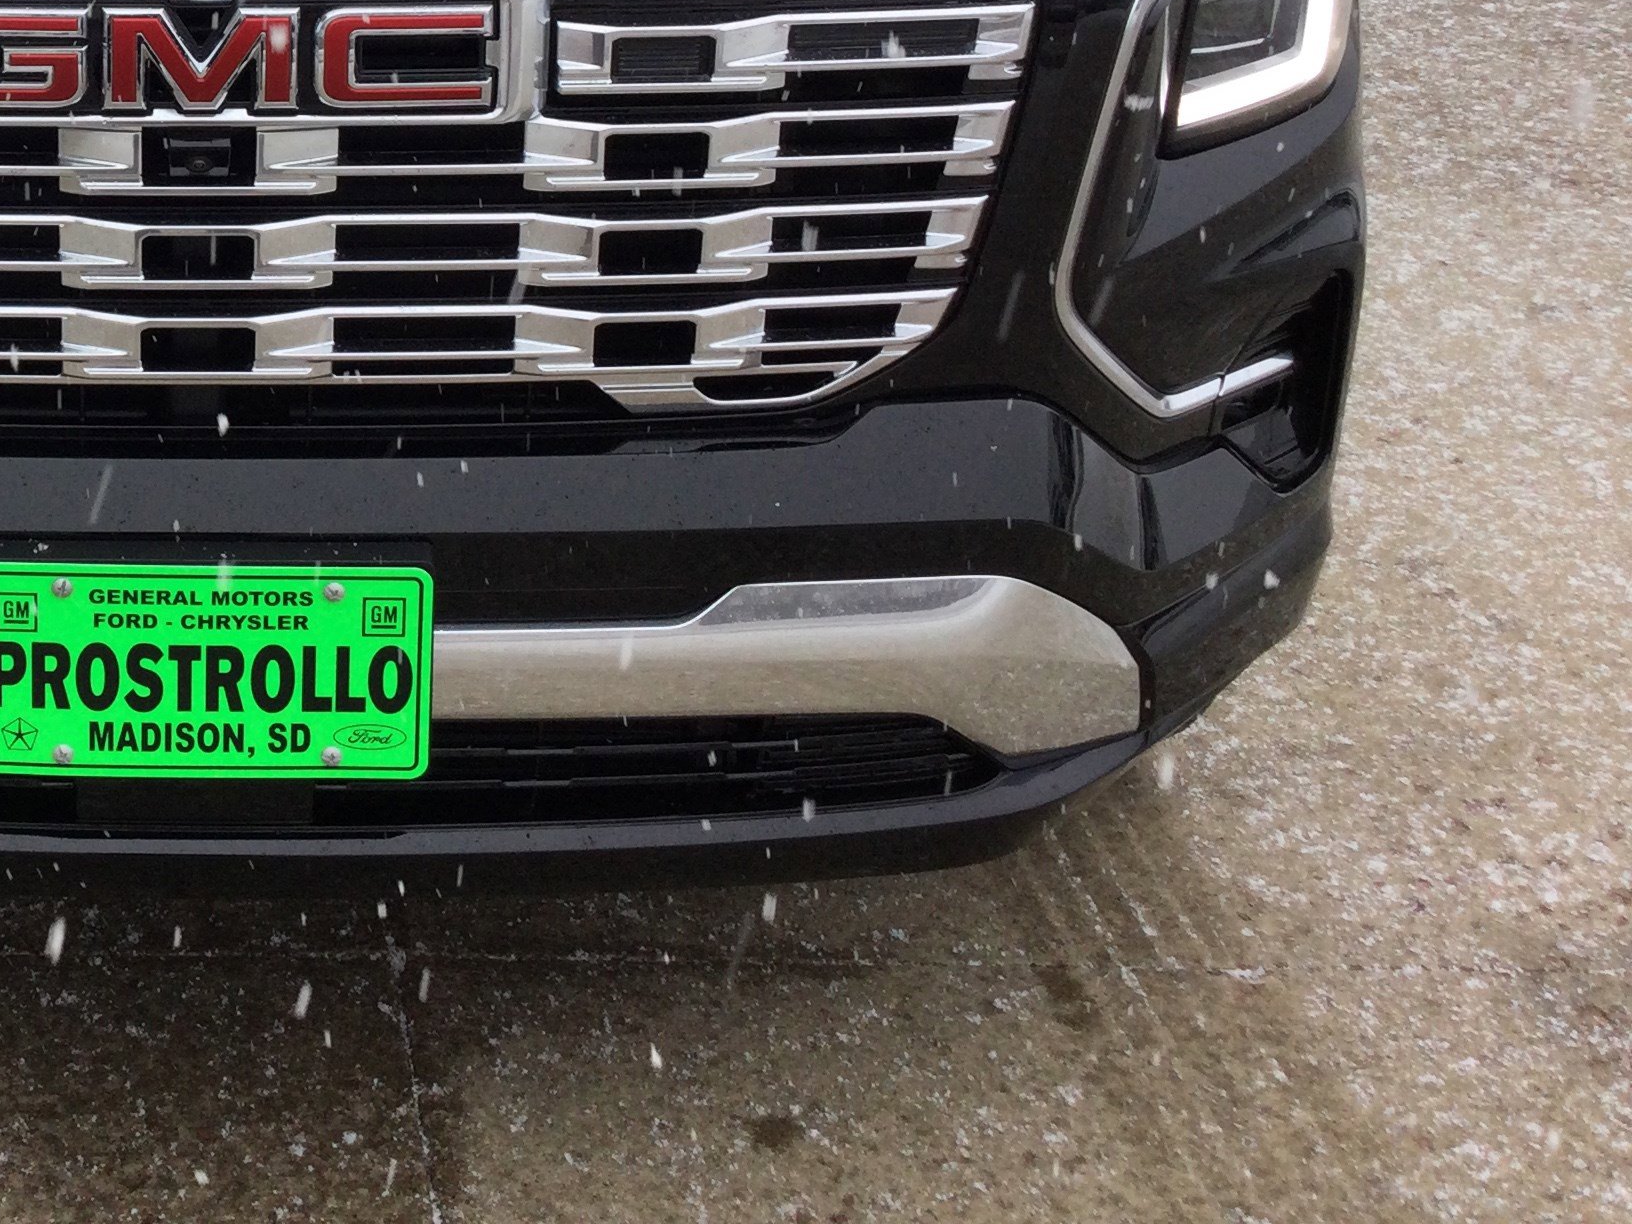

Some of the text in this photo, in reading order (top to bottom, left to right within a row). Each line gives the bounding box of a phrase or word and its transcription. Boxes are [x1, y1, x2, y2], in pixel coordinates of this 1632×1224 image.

[88, 588, 314, 607] GENERAL MOTORS
[2, 599, 31, 619] GM
[371, 605, 398, 624] GM
[93, 613, 158, 629] FORD
[181, 614, 309, 631] CHRYSLER
[88, 721, 312, 759] MADISON, SD
[347, 728, 394, 745] Ford
